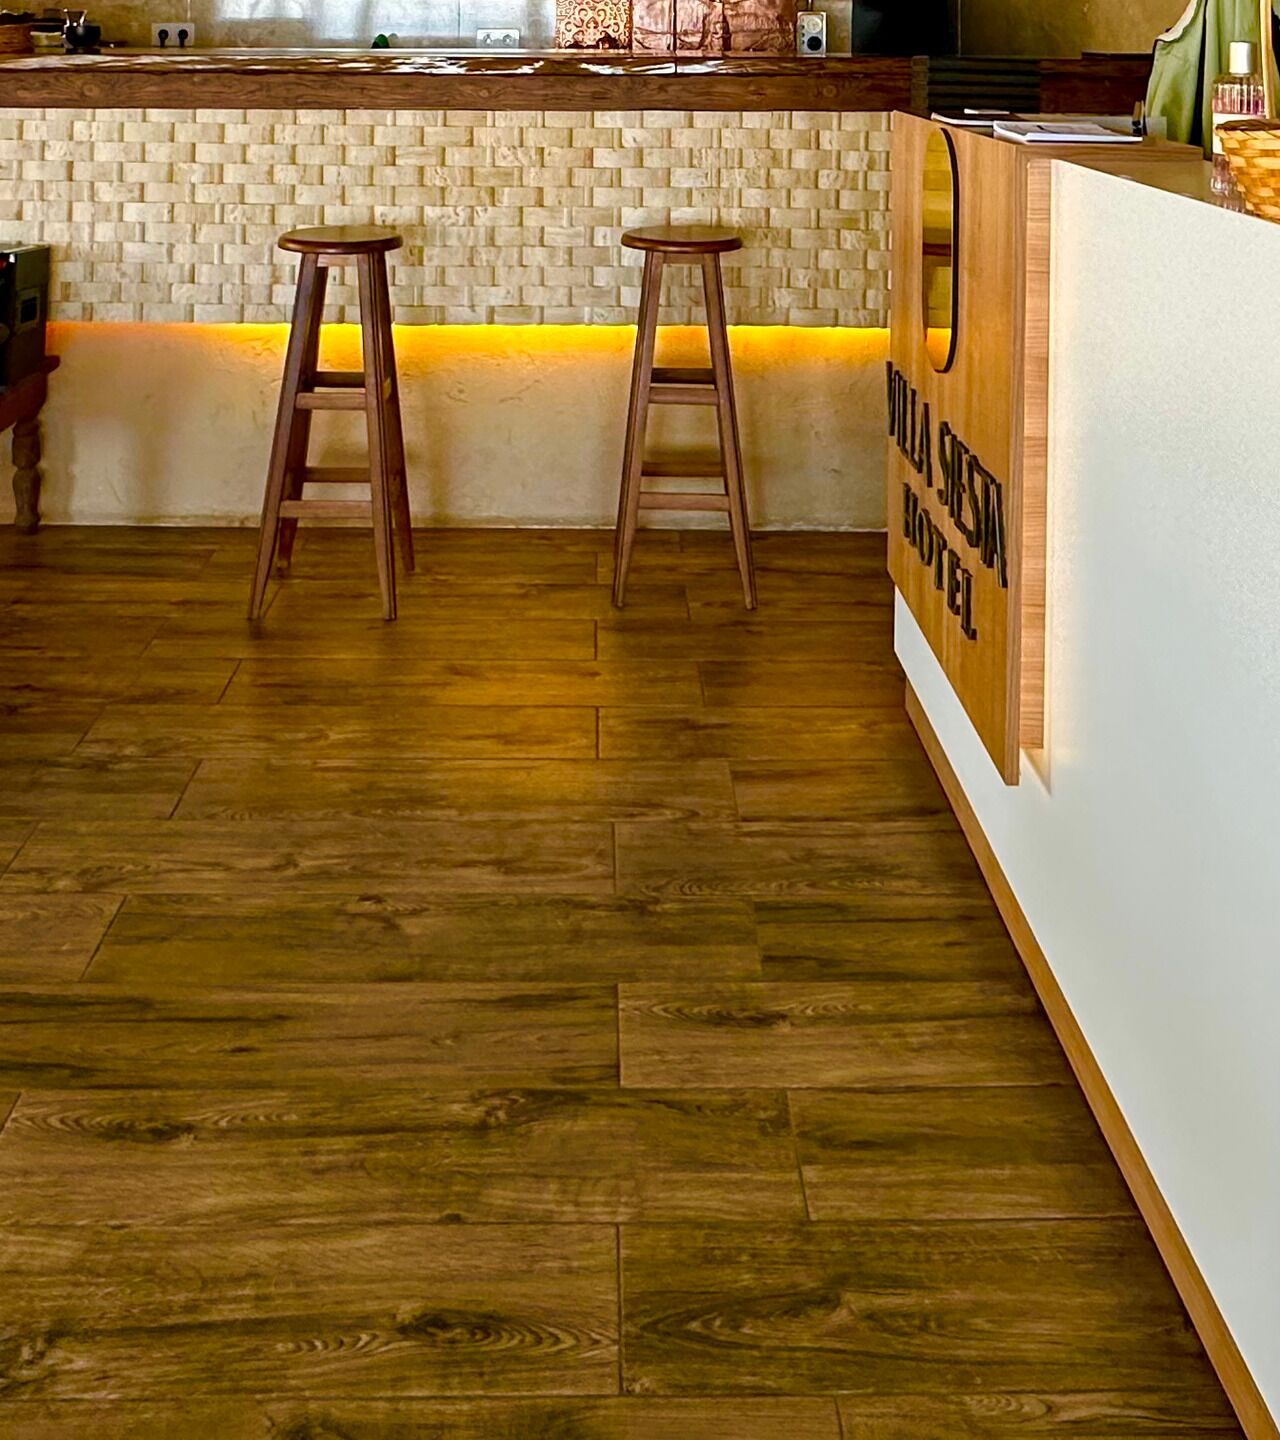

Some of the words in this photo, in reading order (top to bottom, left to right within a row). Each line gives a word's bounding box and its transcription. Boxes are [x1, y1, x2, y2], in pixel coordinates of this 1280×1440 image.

[885, 361, 933, 488] VILLA
[937, 421, 1008, 588] SIESTA
[903, 482, 977, 640] HOTEL
